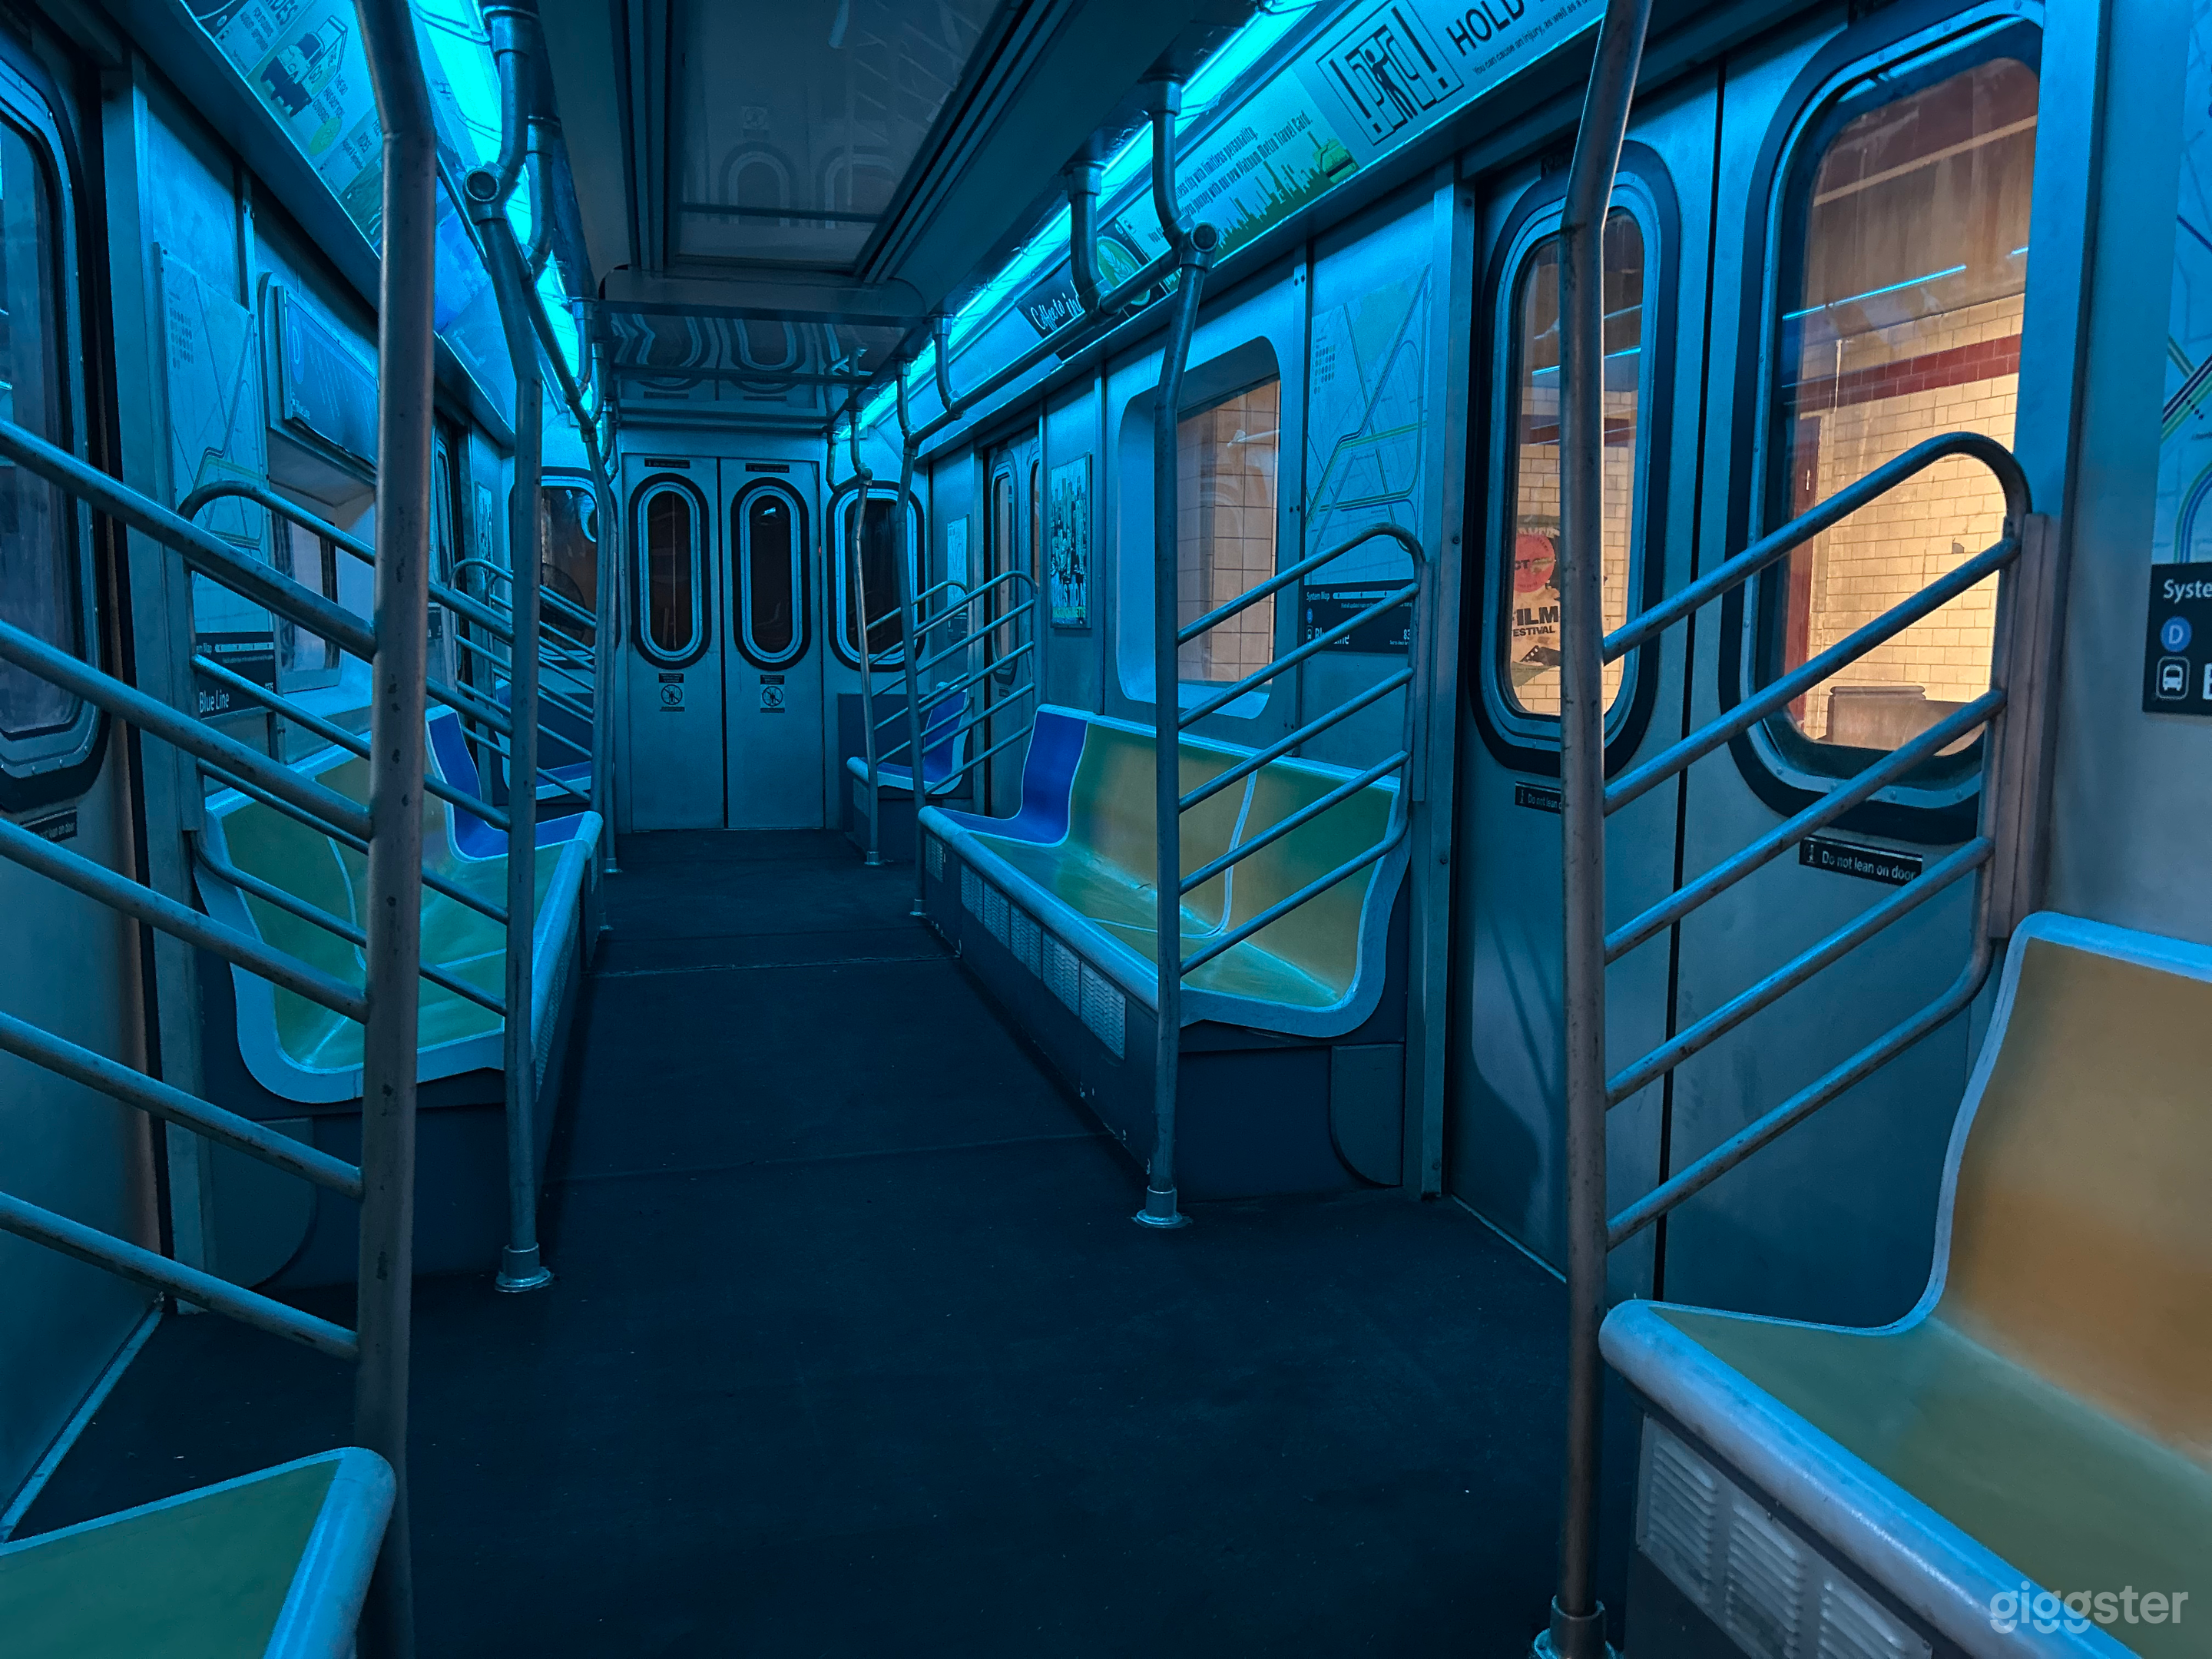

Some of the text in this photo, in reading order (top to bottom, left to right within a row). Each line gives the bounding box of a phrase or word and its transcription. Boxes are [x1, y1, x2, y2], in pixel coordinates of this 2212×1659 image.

[1445, 0, 1525, 57] HOLD
[1473, 64, 1487, 75] You
[1485, 57, 1498, 68] can
[1496, 46, 1515, 61] cause
[1515, 38, 1524, 48] an
[1523, 26, 1545, 44] injury,
[1544, 19, 1553, 28] as
[1551, 6, 1568, 22] well
[1567, 2, 1576, 13] as
[1223, 126, 1258, 161] personality.
[1257, 137, 1279, 159] Metro
[1273, 121, 1296, 147] Travel
[1291, 110, 1313, 132] Card.
[1306, 591, 1320, 602] System
[1512, 606, 1559, 626] ILM
[1512, 625, 1555, 637] ESTIVAL
[2168, 624, 2184, 644] D
[200, 689, 229, 713] Blue Line
[1822, 850, 1917, 881] Do not lean on door
